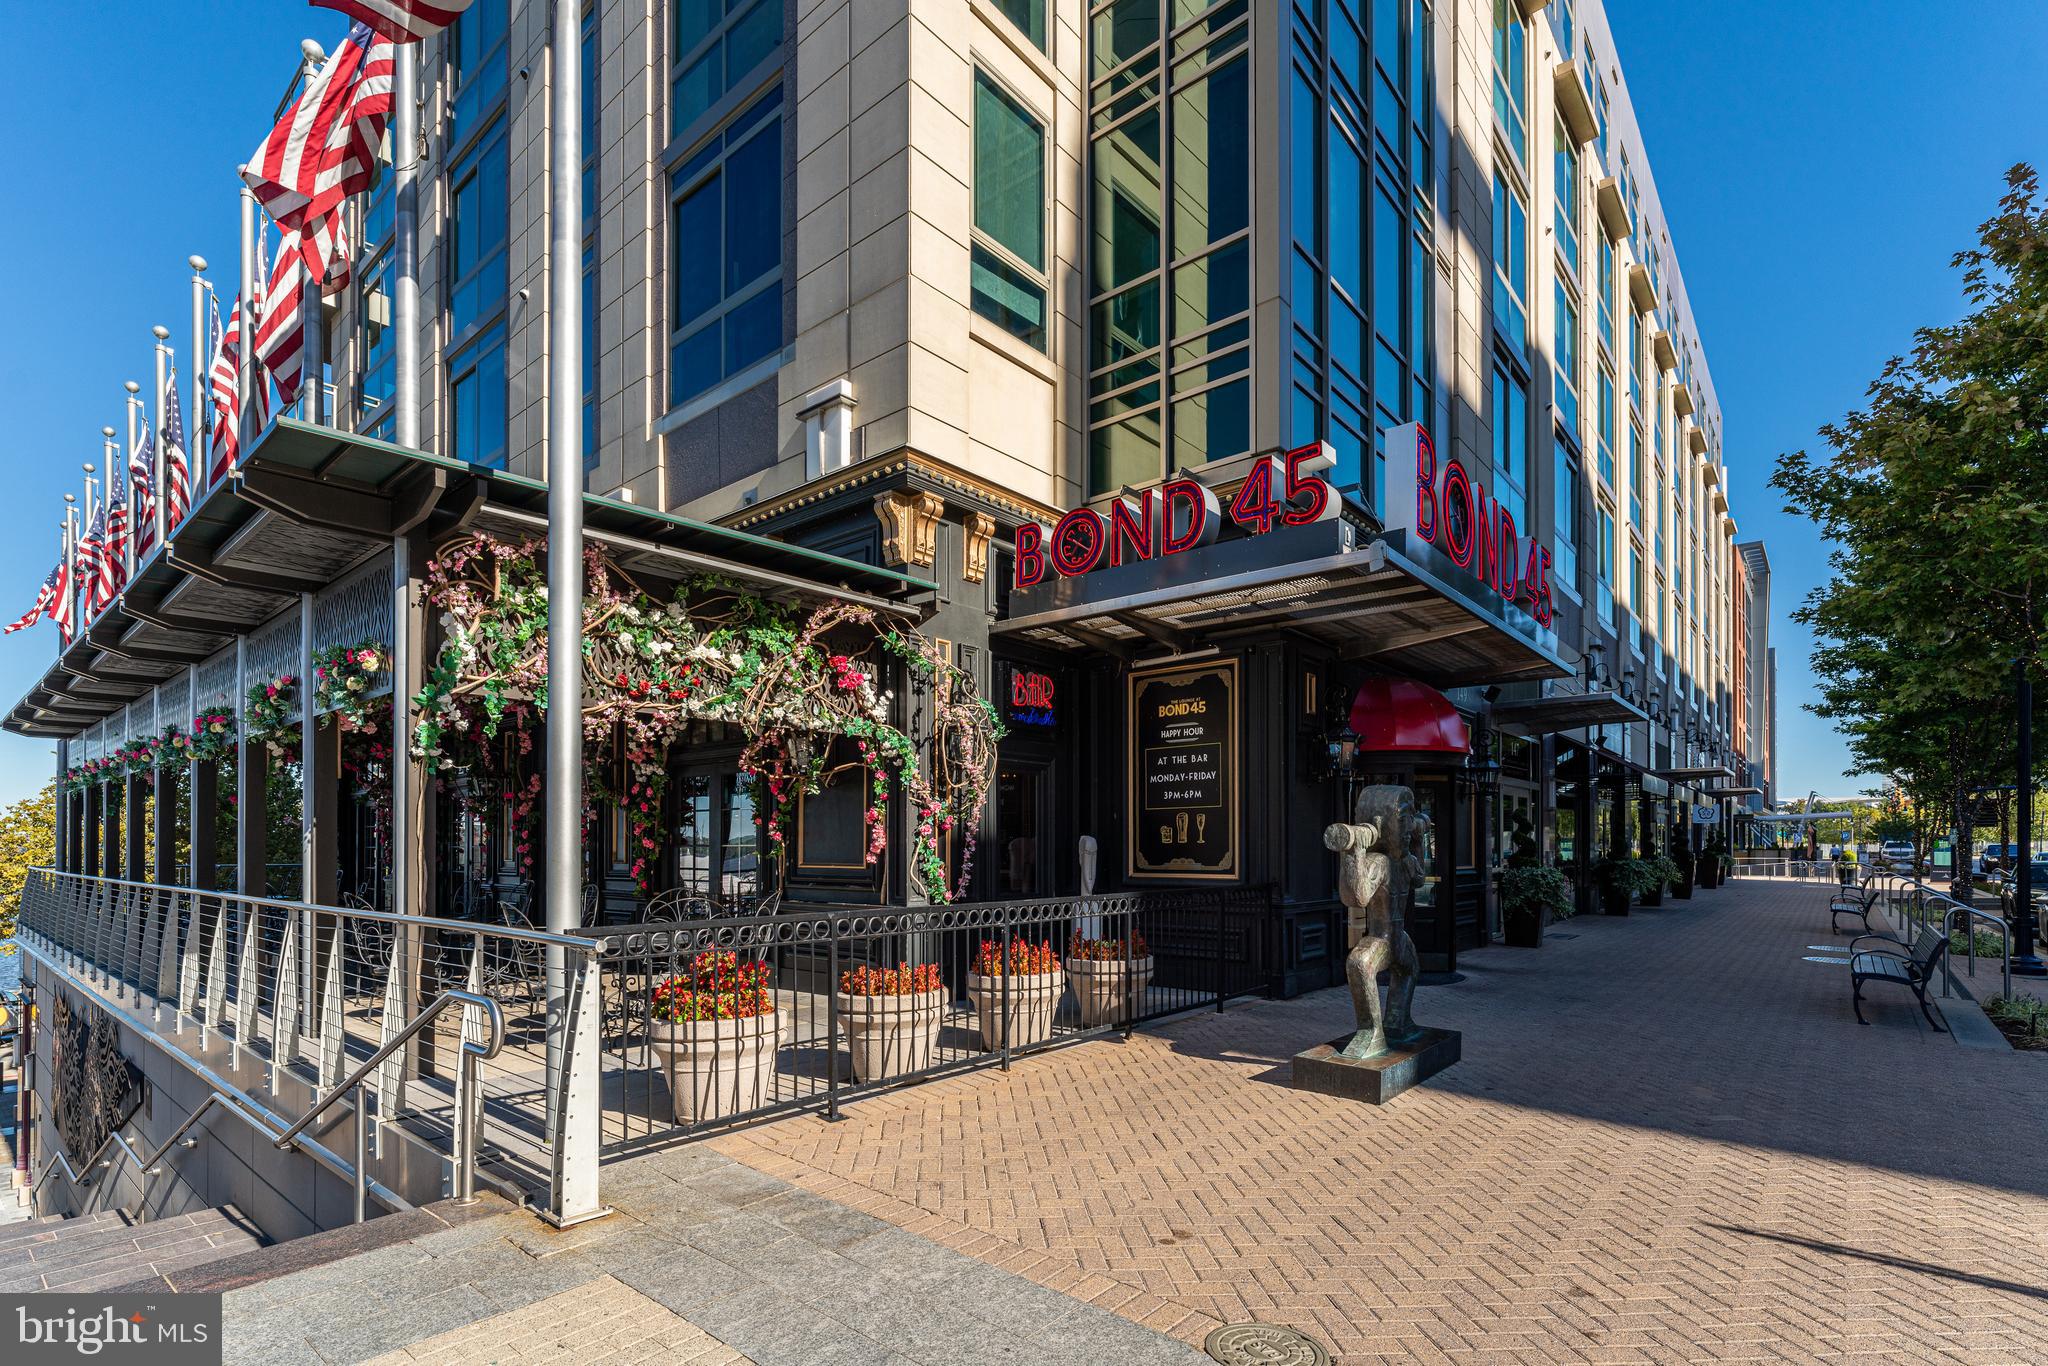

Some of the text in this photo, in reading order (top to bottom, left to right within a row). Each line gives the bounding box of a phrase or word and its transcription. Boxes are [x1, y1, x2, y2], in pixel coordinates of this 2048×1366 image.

[1015, 440, 1332, 589] BOND 45
[1416, 422, 1552, 628] BOND 45
[1013, 673, 1054, 709] BAR
[1159, 701, 1206, 717] BOND 45
[1161, 727, 1204, 738] HAPPY HOUR
[1158, 753, 1208, 765] AT THE BAR
[1150, 771, 1216, 783] MONDAY-FRIDAY
[1163, 790, 1202, 800] 3PM-6PM
